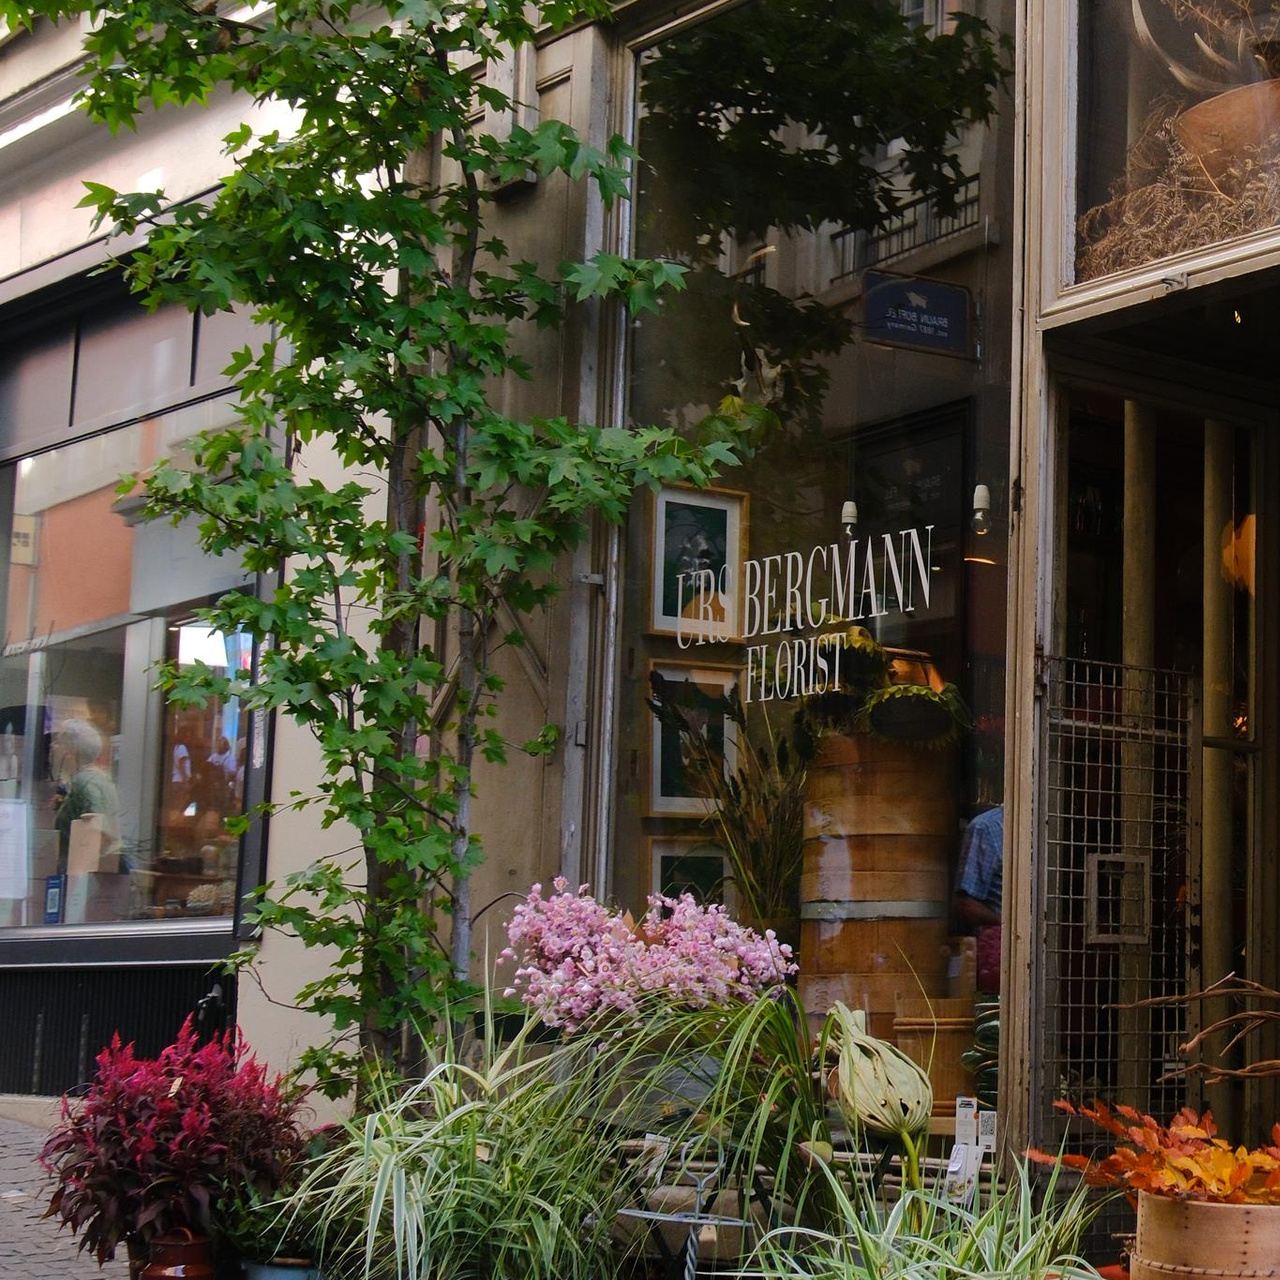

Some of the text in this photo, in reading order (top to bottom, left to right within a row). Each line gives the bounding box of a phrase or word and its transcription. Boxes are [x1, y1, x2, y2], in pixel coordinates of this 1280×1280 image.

[675, 524, 936, 650] URS BERGMANN
[745, 631, 848, 704] FLORIST
